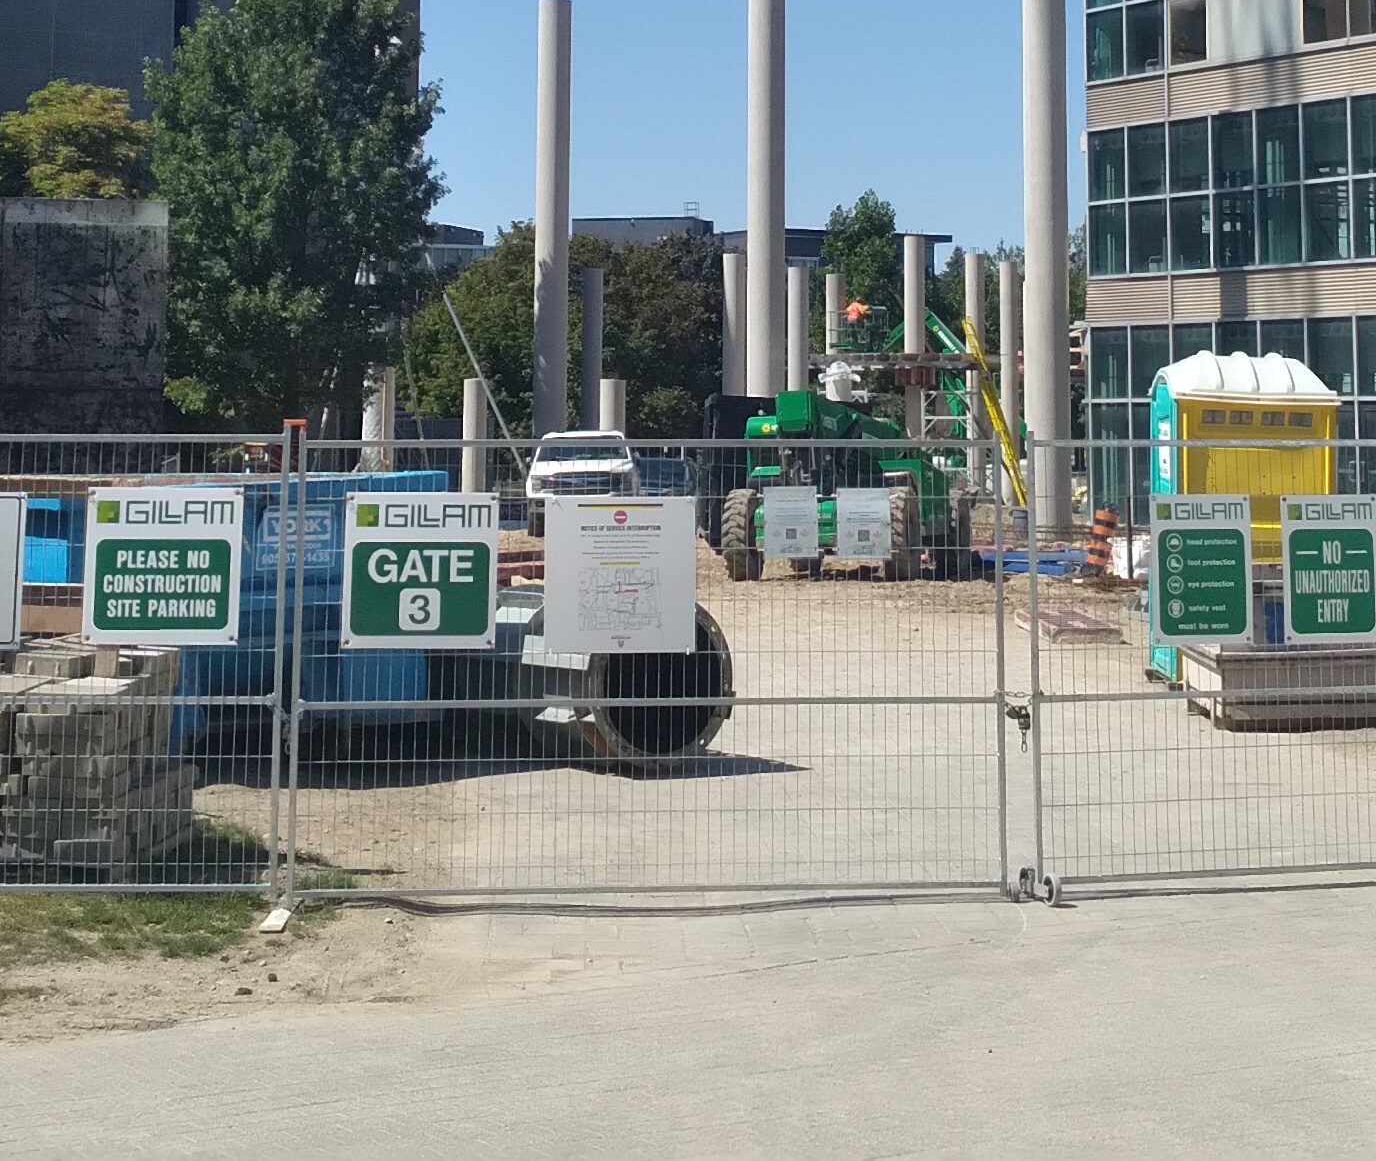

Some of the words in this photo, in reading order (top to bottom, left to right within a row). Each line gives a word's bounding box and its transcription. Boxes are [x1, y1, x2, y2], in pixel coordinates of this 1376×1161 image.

[126, 501, 234, 524] GILLAM
[385, 504, 491, 528] GILLAM
[1175, 503, 1243, 520] GILLAM
[1306, 503, 1372, 520] GILLAM
[116, 550, 179, 568] PLEASE
[187, 550, 210, 568] NO
[1323, 540, 1341, 565] NO
[368, 548, 474, 584] GATE
[103, 574, 221, 594] CONSTRUCTION
[1295, 570, 1369, 594] UNAUTHORIZED
[106, 599, 140, 617] SITE
[148, 599, 216, 617] PARKING
[408, 594, 431, 624] 3
[1317, 599, 1349, 623] ENTRY
